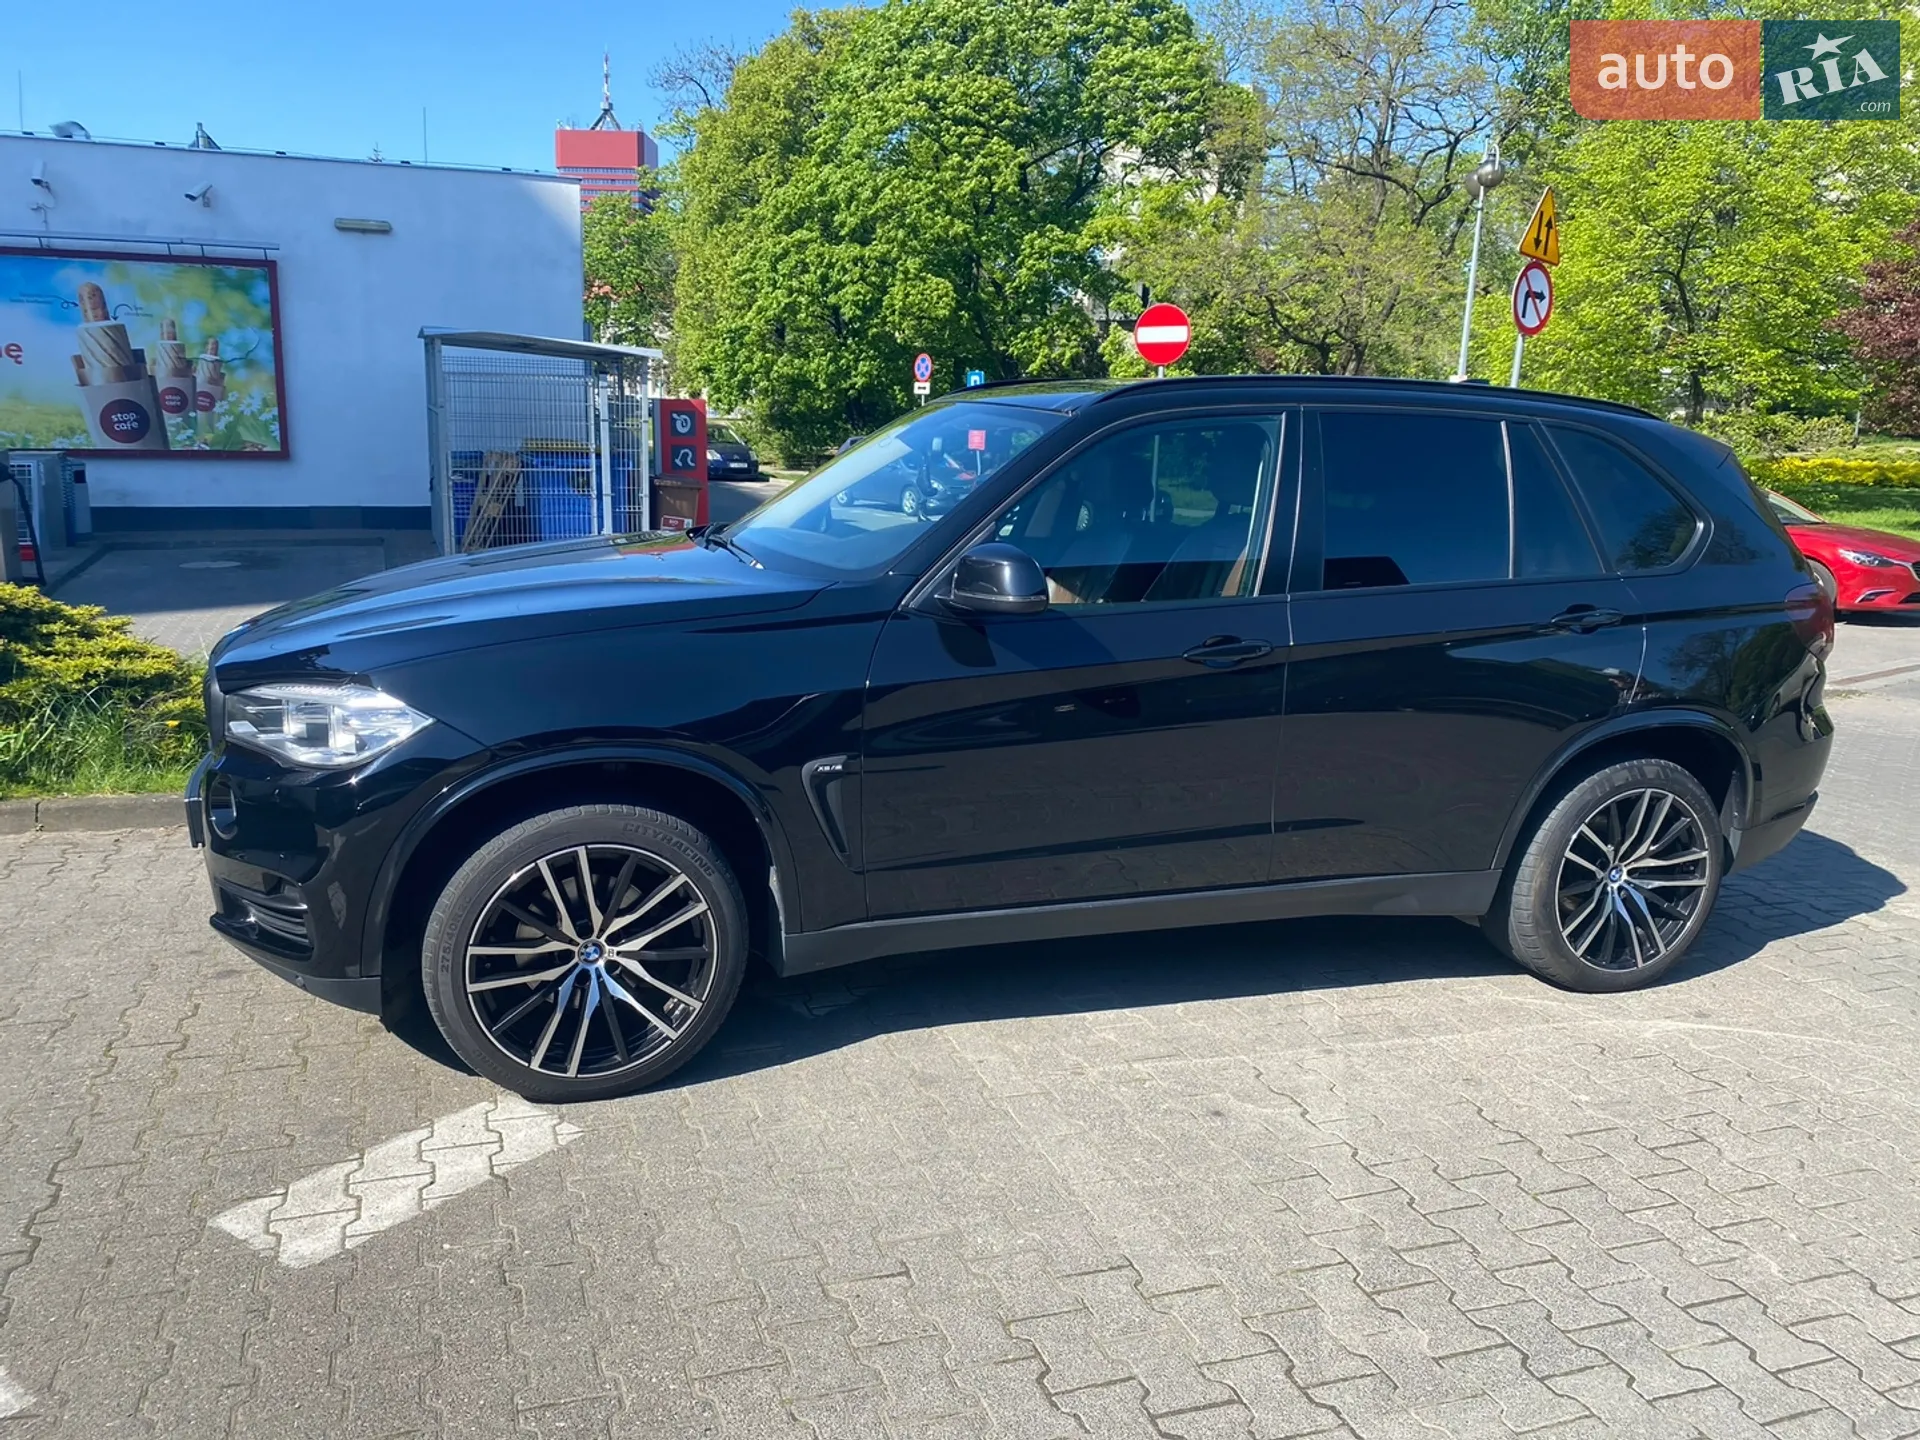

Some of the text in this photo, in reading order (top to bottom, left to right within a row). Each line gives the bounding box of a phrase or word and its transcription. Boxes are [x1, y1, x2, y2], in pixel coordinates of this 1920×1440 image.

[0, 342, 24, 365] ę
[113, 420, 139, 431] cafe
[622, 822, 716, 878] CITYRACING
